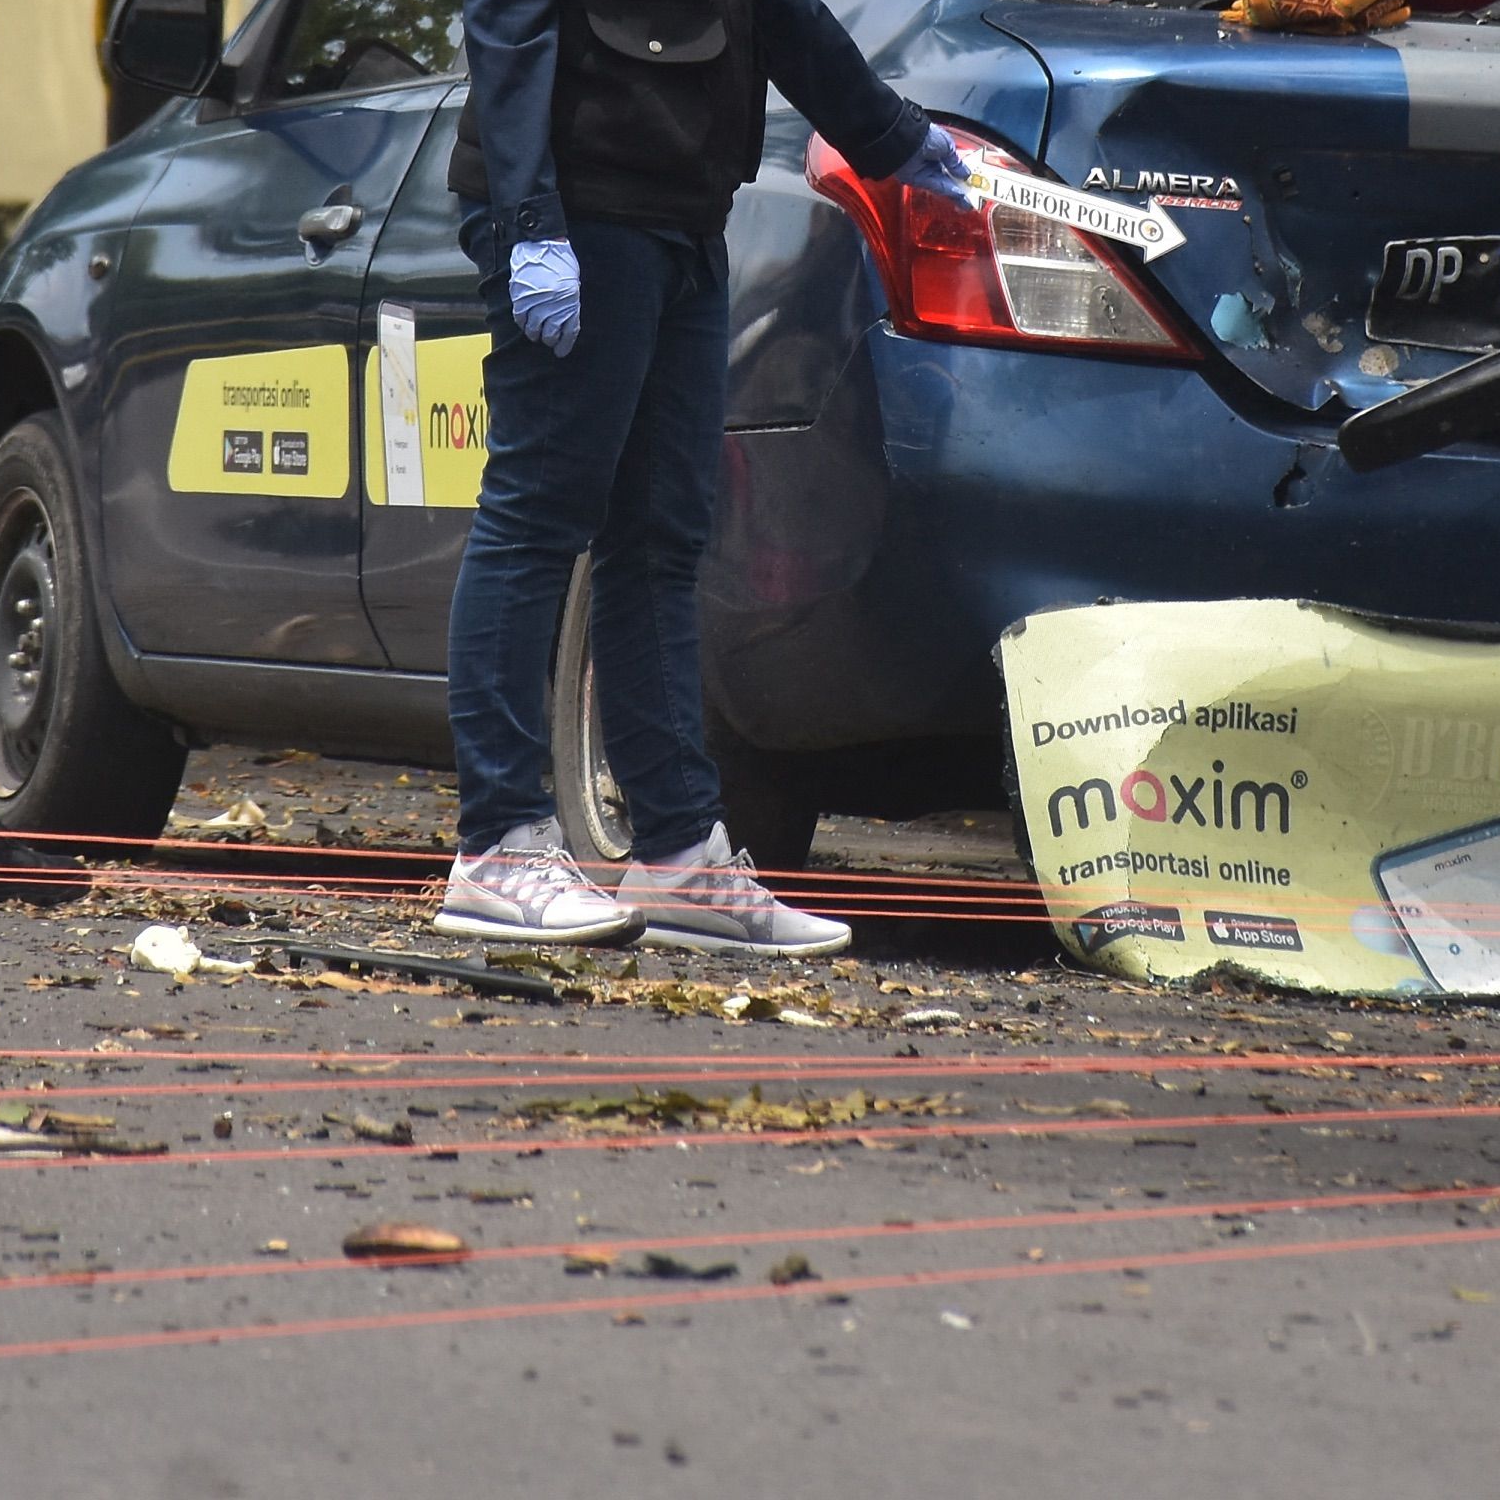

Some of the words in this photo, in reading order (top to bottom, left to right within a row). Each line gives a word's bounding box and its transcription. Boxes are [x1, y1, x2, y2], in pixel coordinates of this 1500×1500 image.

[1081, 167, 1242, 198] ALMERA
[993, 179, 1071, 218] LABFOR
[1077, 207, 1136, 238] POLRI
[1189, 197, 1242, 210] RACING
[1396, 246, 1463, 304] DP
[223, 380, 279, 412] transportasi
[280, 380, 311, 409] online
[430, 387, 488, 450] maxi
[1032, 700, 1187, 747] Download
[1195, 702, 1299, 736] aplikasi
[1058, 850, 1210, 886] transportasi
[1219, 860, 1292, 887] online
[1434, 852, 1473, 872] maxim
[1104, 917, 1152, 934] Google
[1153, 918, 1176, 937] Play
[1234, 928, 1260, 944] App
[1260, 930, 1295, 946] Store
